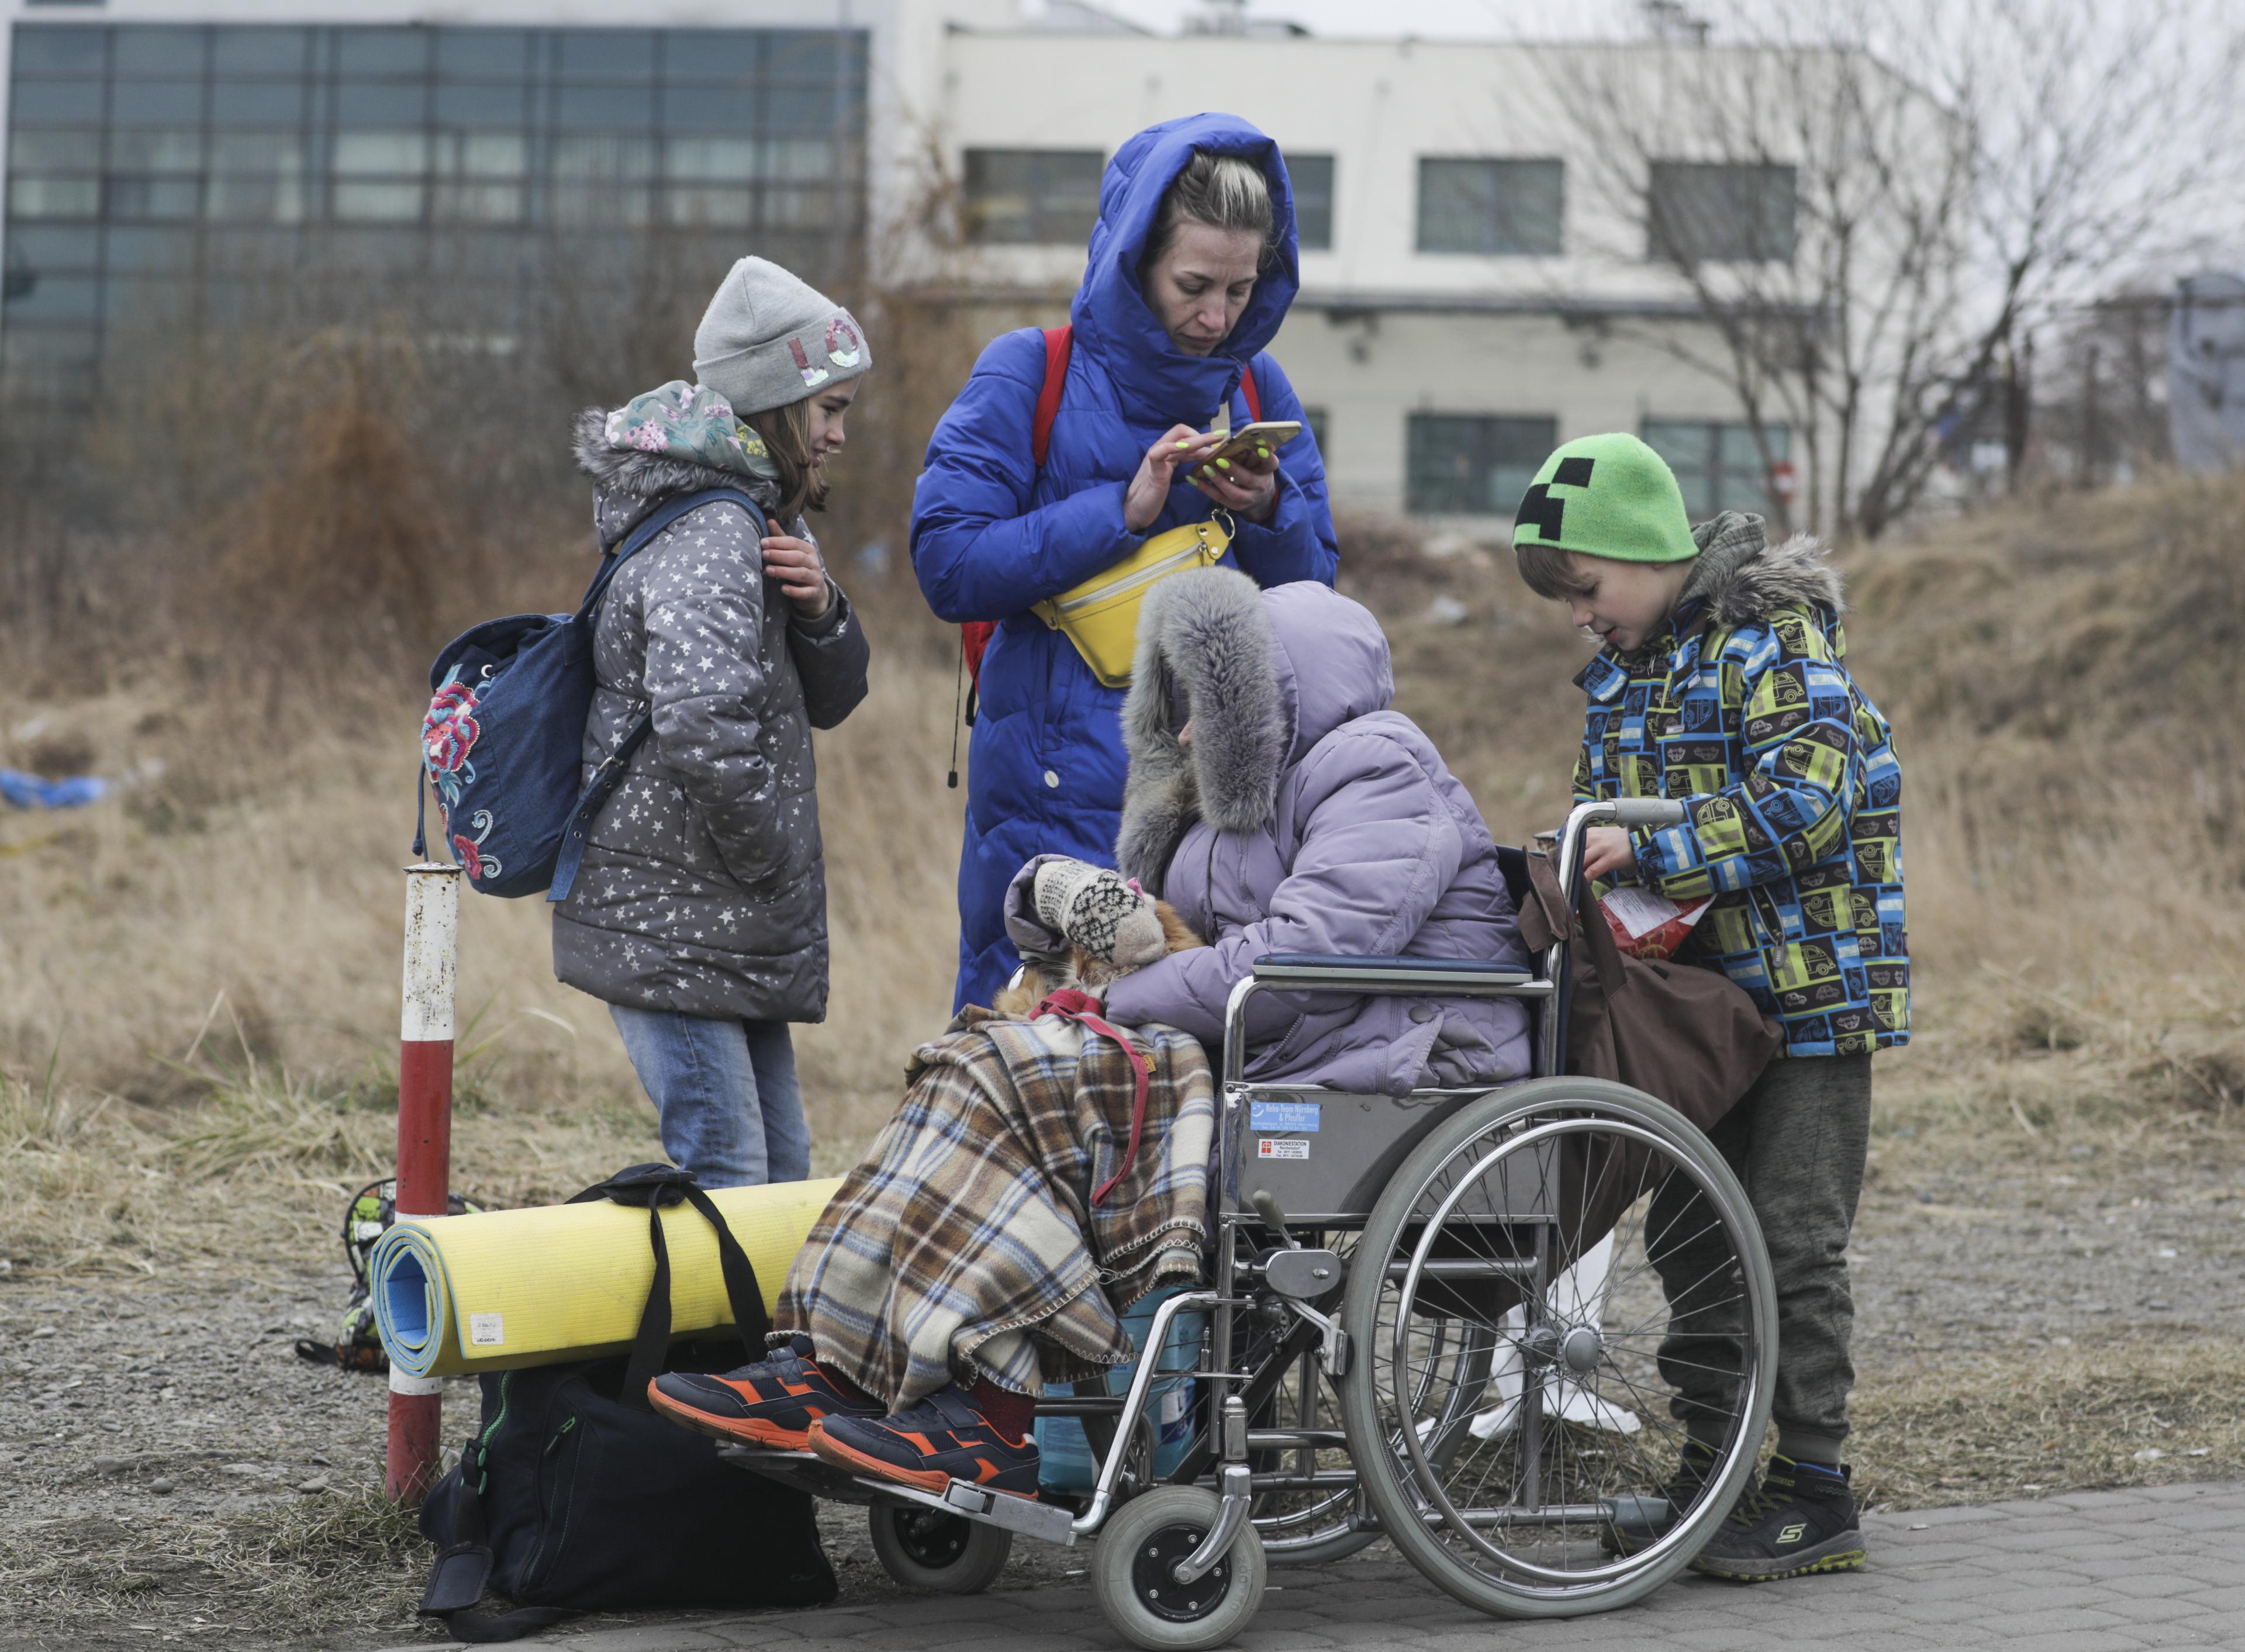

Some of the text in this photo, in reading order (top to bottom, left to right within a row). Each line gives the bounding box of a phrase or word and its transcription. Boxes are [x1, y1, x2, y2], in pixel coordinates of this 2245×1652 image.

[788, 314, 865, 387] LO
[1266, 1104, 1318, 1115] Reha-Team Nürnberg
[1279, 1113, 1283, 1121] &
